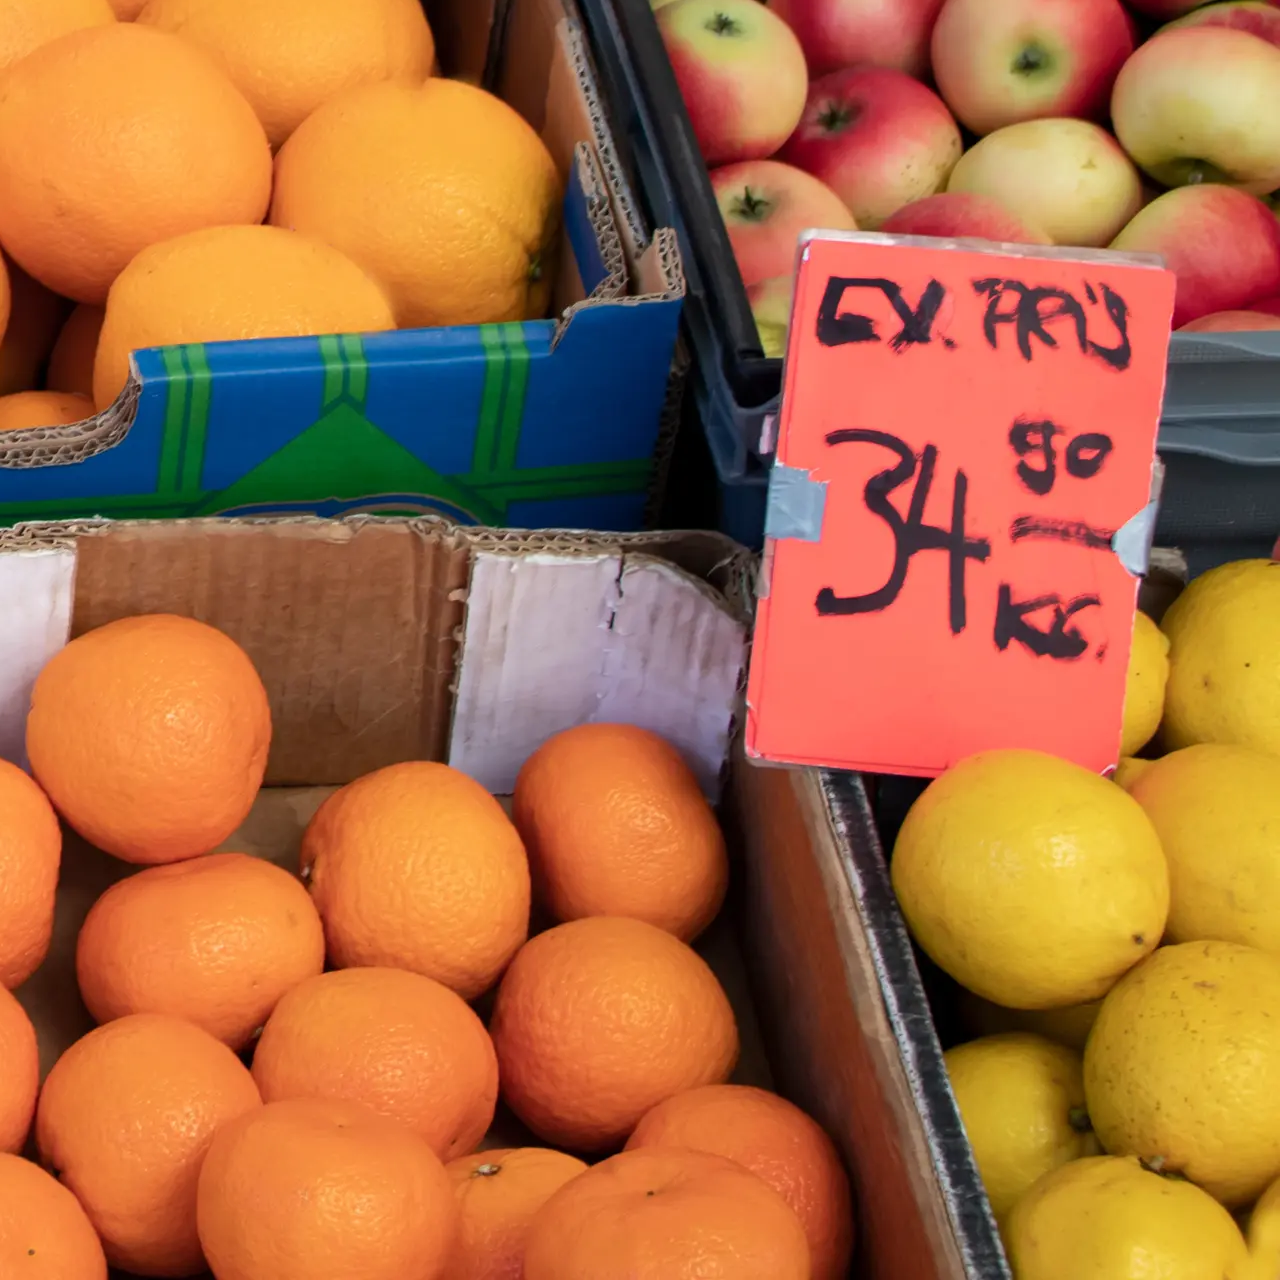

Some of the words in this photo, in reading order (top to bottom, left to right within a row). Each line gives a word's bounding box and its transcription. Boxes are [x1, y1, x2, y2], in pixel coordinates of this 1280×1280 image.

[970, 276, 1133, 372] PRIS
[813, 427, 993, 638] 34
[1008, 415, 1113, 496] 90
